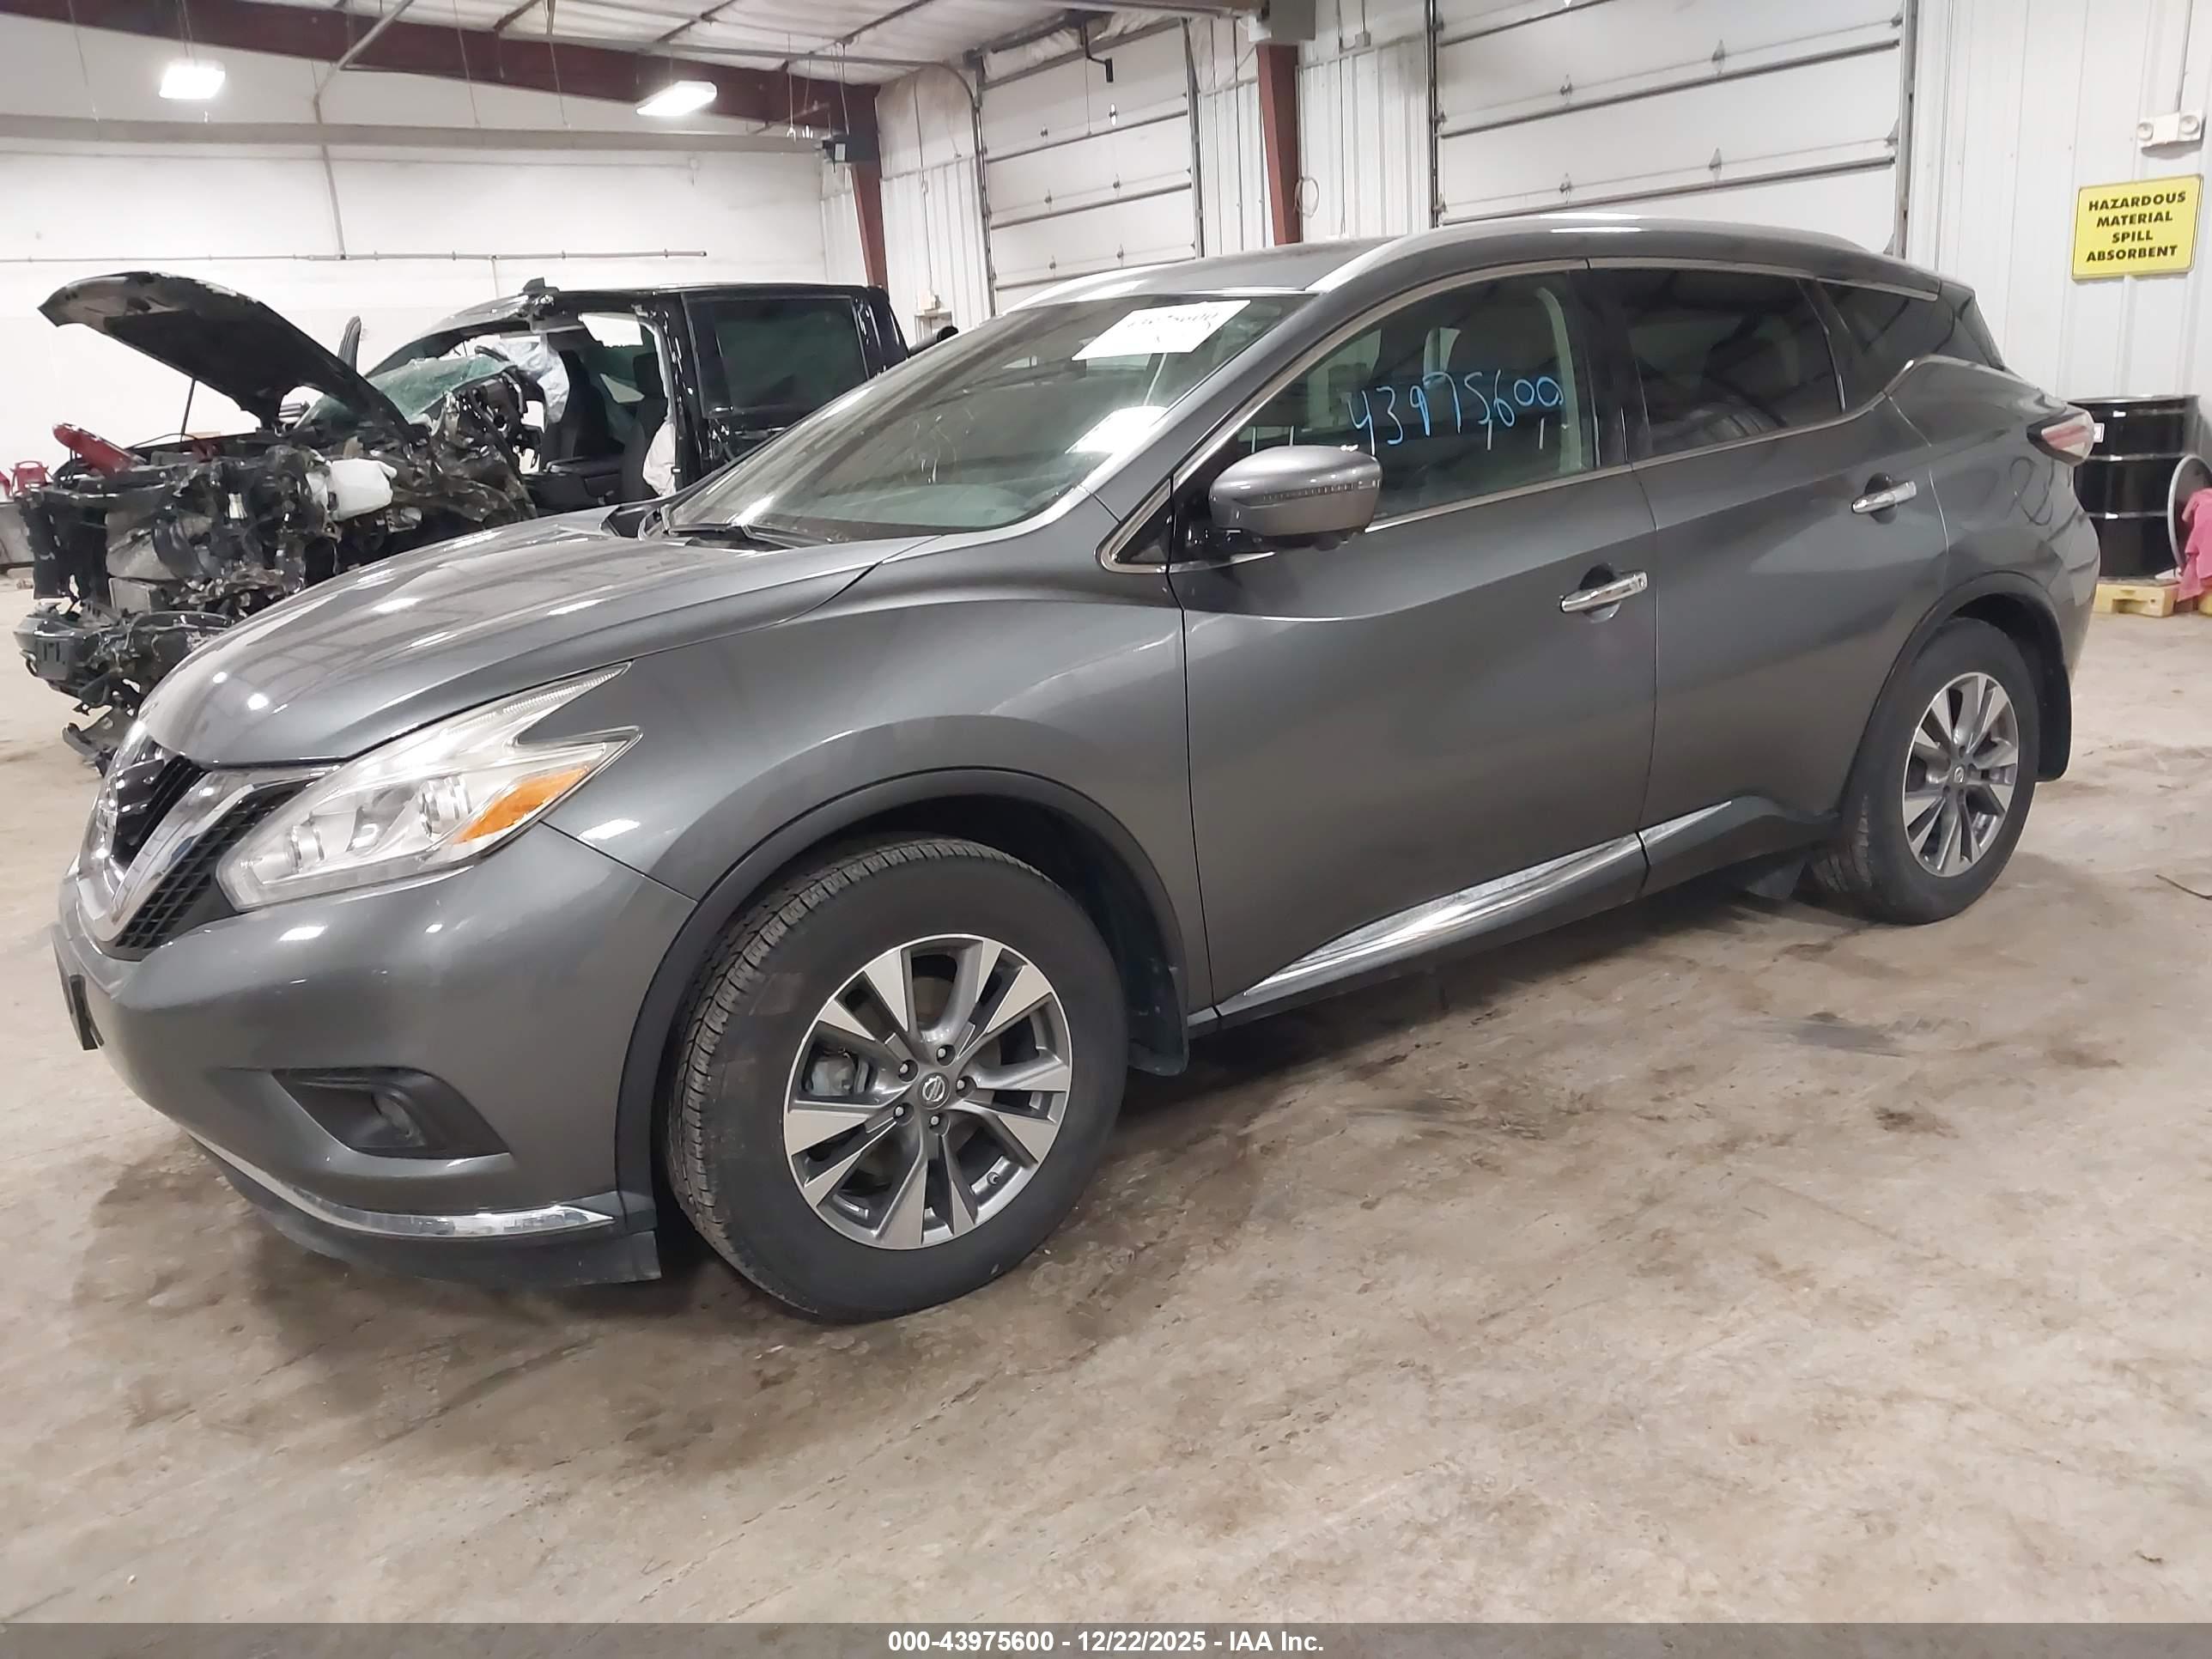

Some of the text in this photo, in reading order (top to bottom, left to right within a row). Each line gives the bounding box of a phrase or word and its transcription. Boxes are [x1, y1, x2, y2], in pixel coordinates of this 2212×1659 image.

[2088, 191, 2186, 211] HAZARDOUS
[2096, 210, 2172, 228] MATERIAL
[2112, 230, 2154, 244] SPILL
[2086, 245, 2179, 263] ABSORBENT
[1346, 368, 1564, 456] 43975600
